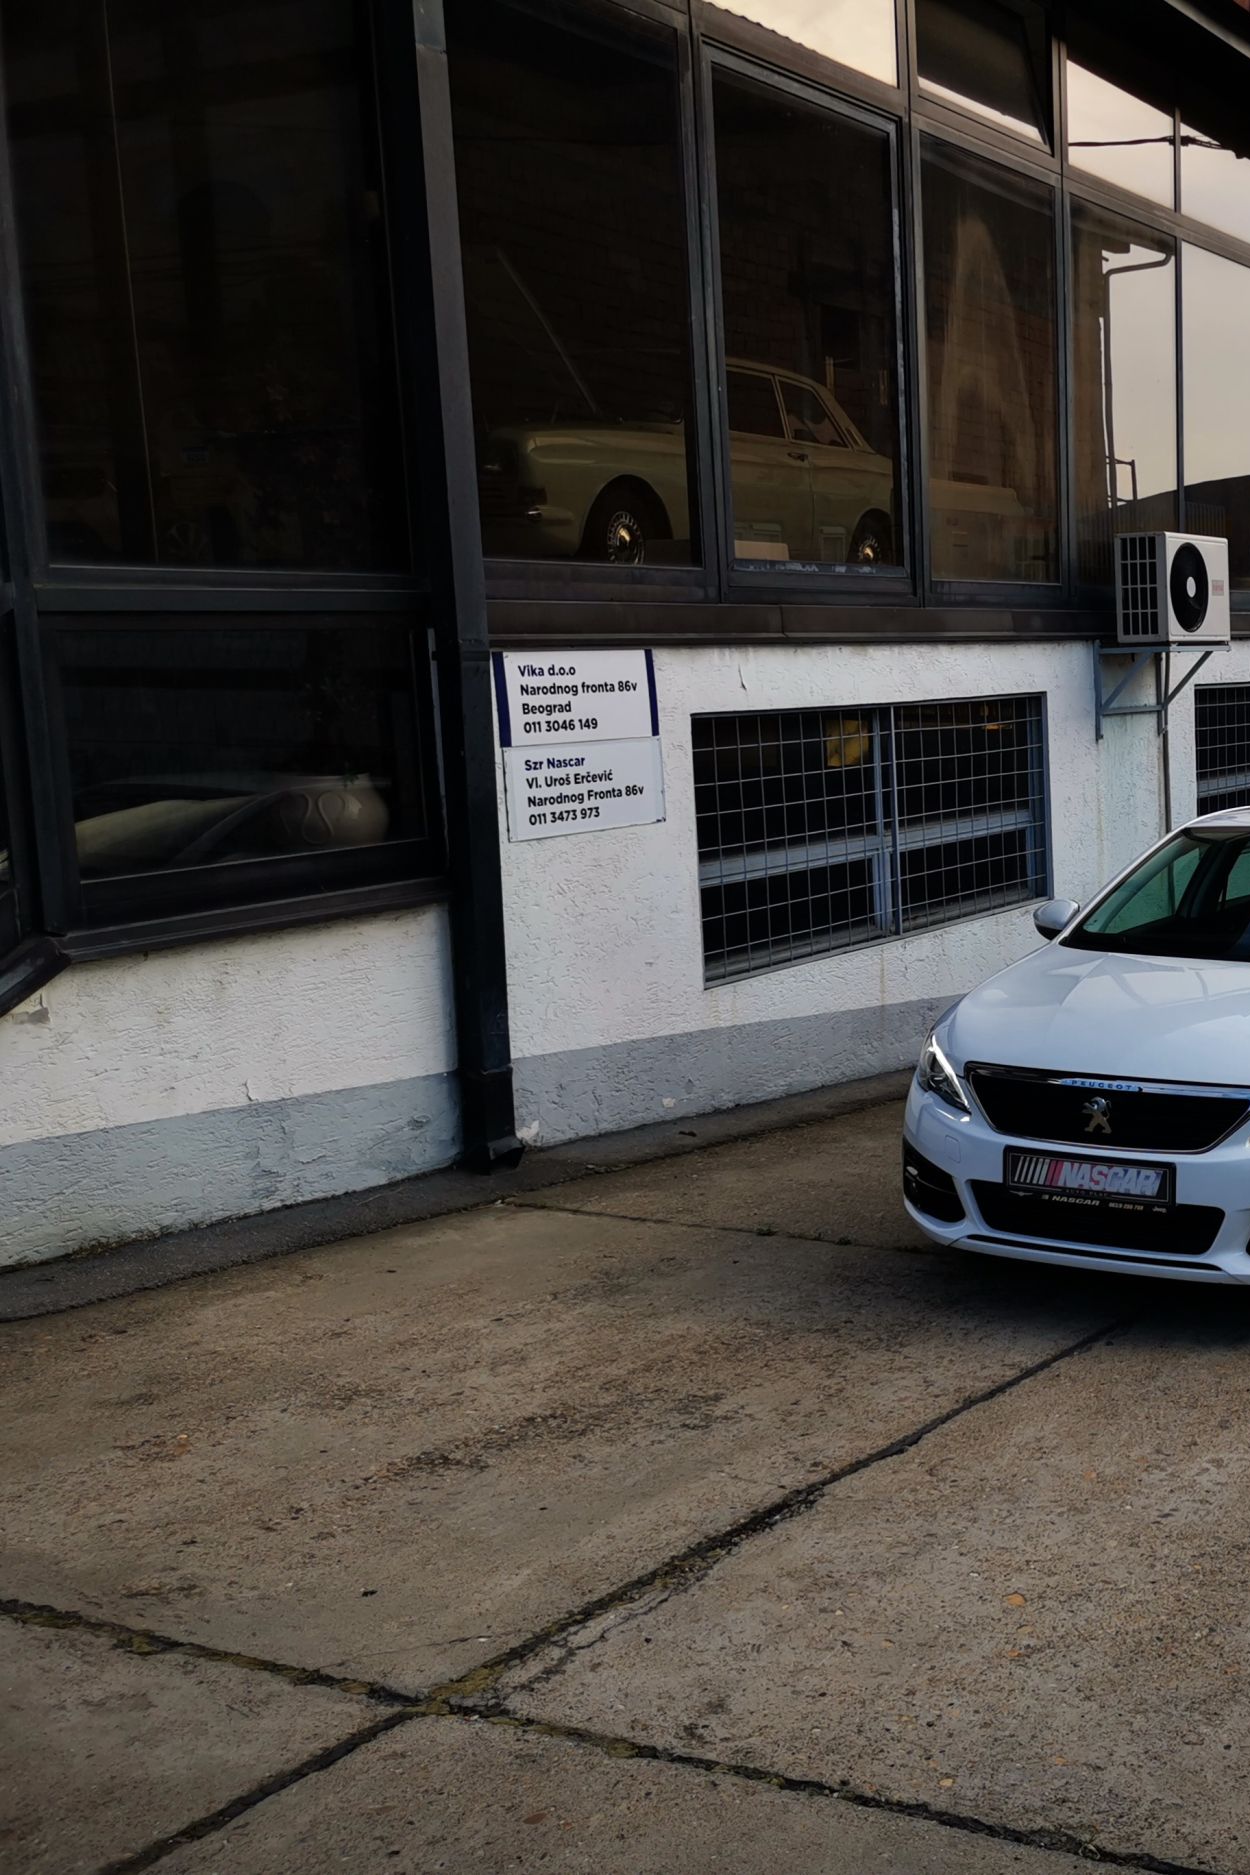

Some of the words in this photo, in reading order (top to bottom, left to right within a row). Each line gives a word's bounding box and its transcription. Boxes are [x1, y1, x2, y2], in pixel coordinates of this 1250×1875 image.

[517, 664, 545, 677] Vika
[547, 664, 576, 677] d.o.o
[520, 683, 578, 697] Narodnog
[581, 681, 615, 694] fronta
[618, 680, 638, 692] 86v
[522, 701, 572, 716] Beograd
[523, 721, 542, 734] 011
[545, 719, 576, 733] 3046
[579, 717, 598, 730] 149
[524, 759, 543, 772] Szr
[546, 756, 586, 770] Nascar
[544, 773, 571, 788] Uroš
[574, 769, 614, 785] Erčević
[527, 792, 585, 808] Narodnog
[587, 788, 623, 802] Fronta
[625, 785, 645, 797] 86v
[529, 814, 547, 826] 011
[550, 809, 578, 823] 3473
[580, 807, 600, 819] 973
[1071, 1079, 1133, 1091] PEUGEOT
[1059, 1160, 1164, 1197] NASCAR
[1052, 1195, 1100, 1207] NASCAR
